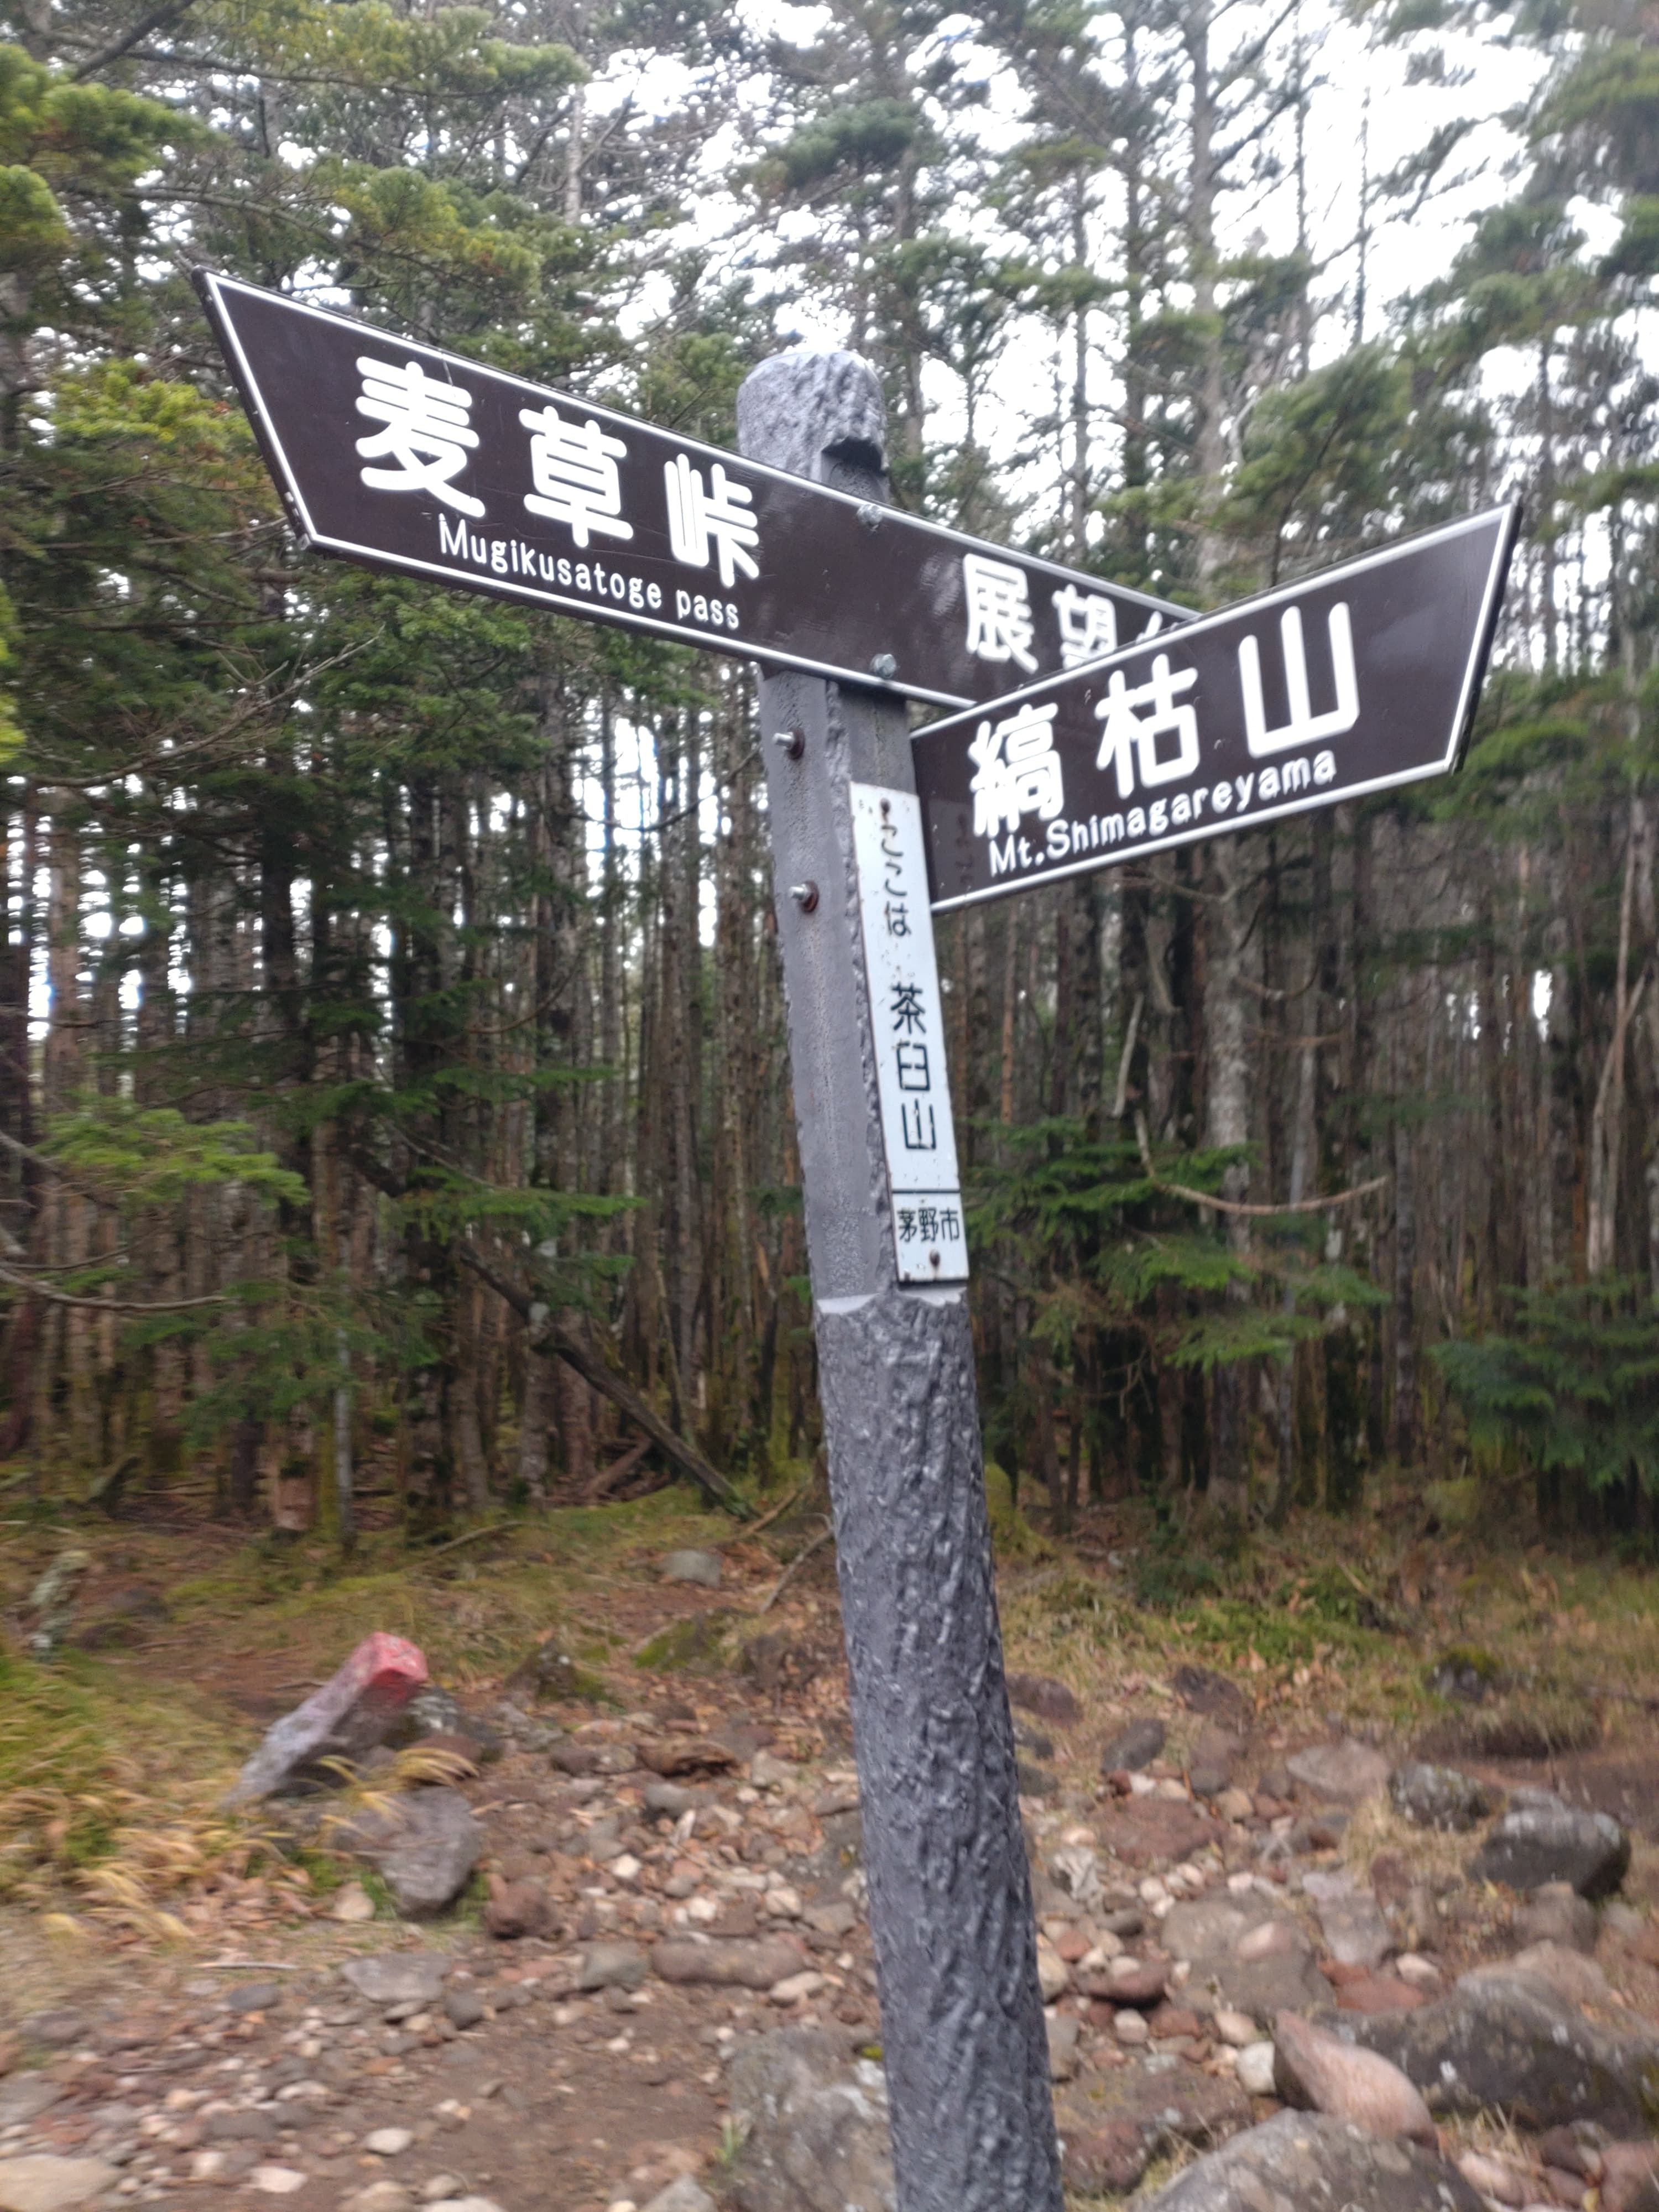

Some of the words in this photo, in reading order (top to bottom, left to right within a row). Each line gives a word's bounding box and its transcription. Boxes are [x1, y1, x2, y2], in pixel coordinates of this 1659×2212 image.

[356, 356, 760, 587] 麦草峠
[439, 513, 662, 610] Mugikusatoge
[676, 587, 739, 630] pass
[963, 553, 1162, 674] 展望
[968, 601, 1360, 838] 縞枯山
[890, 982, 937, 1150] 茶臼山
[896, 1206, 961, 1243] 茅野市
